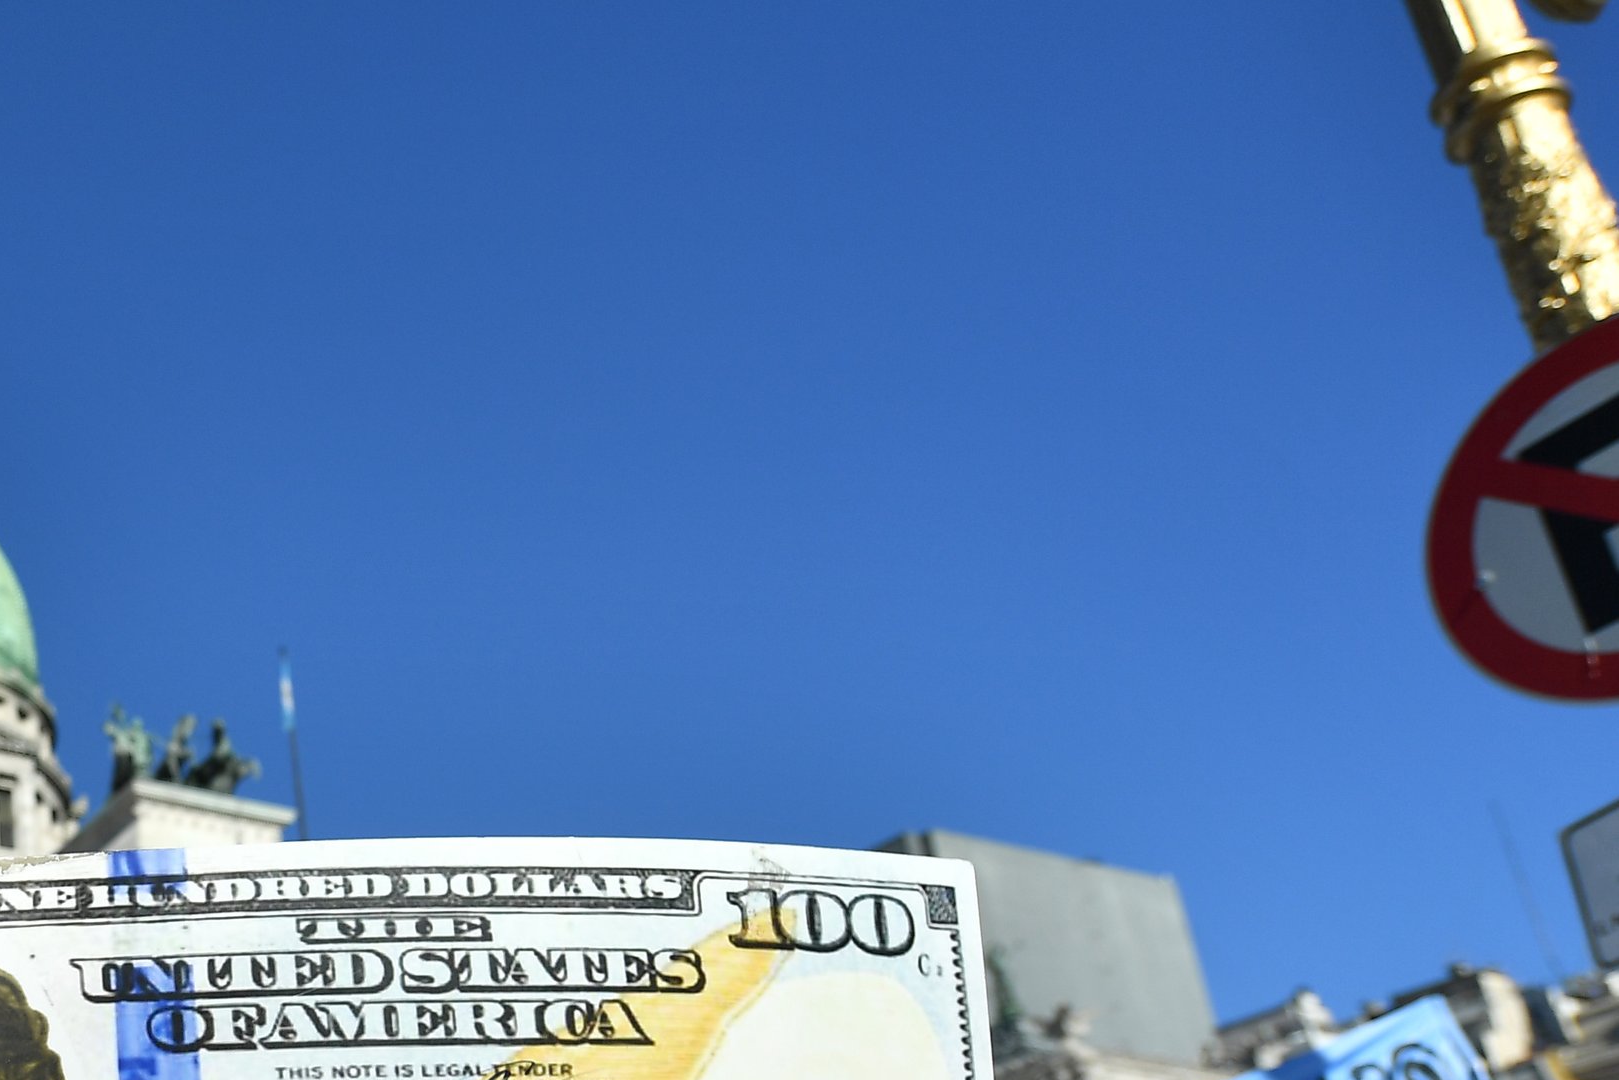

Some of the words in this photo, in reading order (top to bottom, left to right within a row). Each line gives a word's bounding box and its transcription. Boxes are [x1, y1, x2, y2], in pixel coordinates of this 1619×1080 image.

[83, 873, 393, 908] HUNDRED
[400, 872, 683, 899] DOLLARS
[726, 888, 915, 957] 100
[70, 949, 395, 1003] UNITED
[399, 948, 706, 993] STATES
[262, 999, 655, 1048] AMERICA
[275, 1066, 324, 1080] THIS
[331, 1065, 389, 1079] NOTE
[395, 1064, 414, 1078] IS
[421, 1064, 488, 1078] LEGAL
